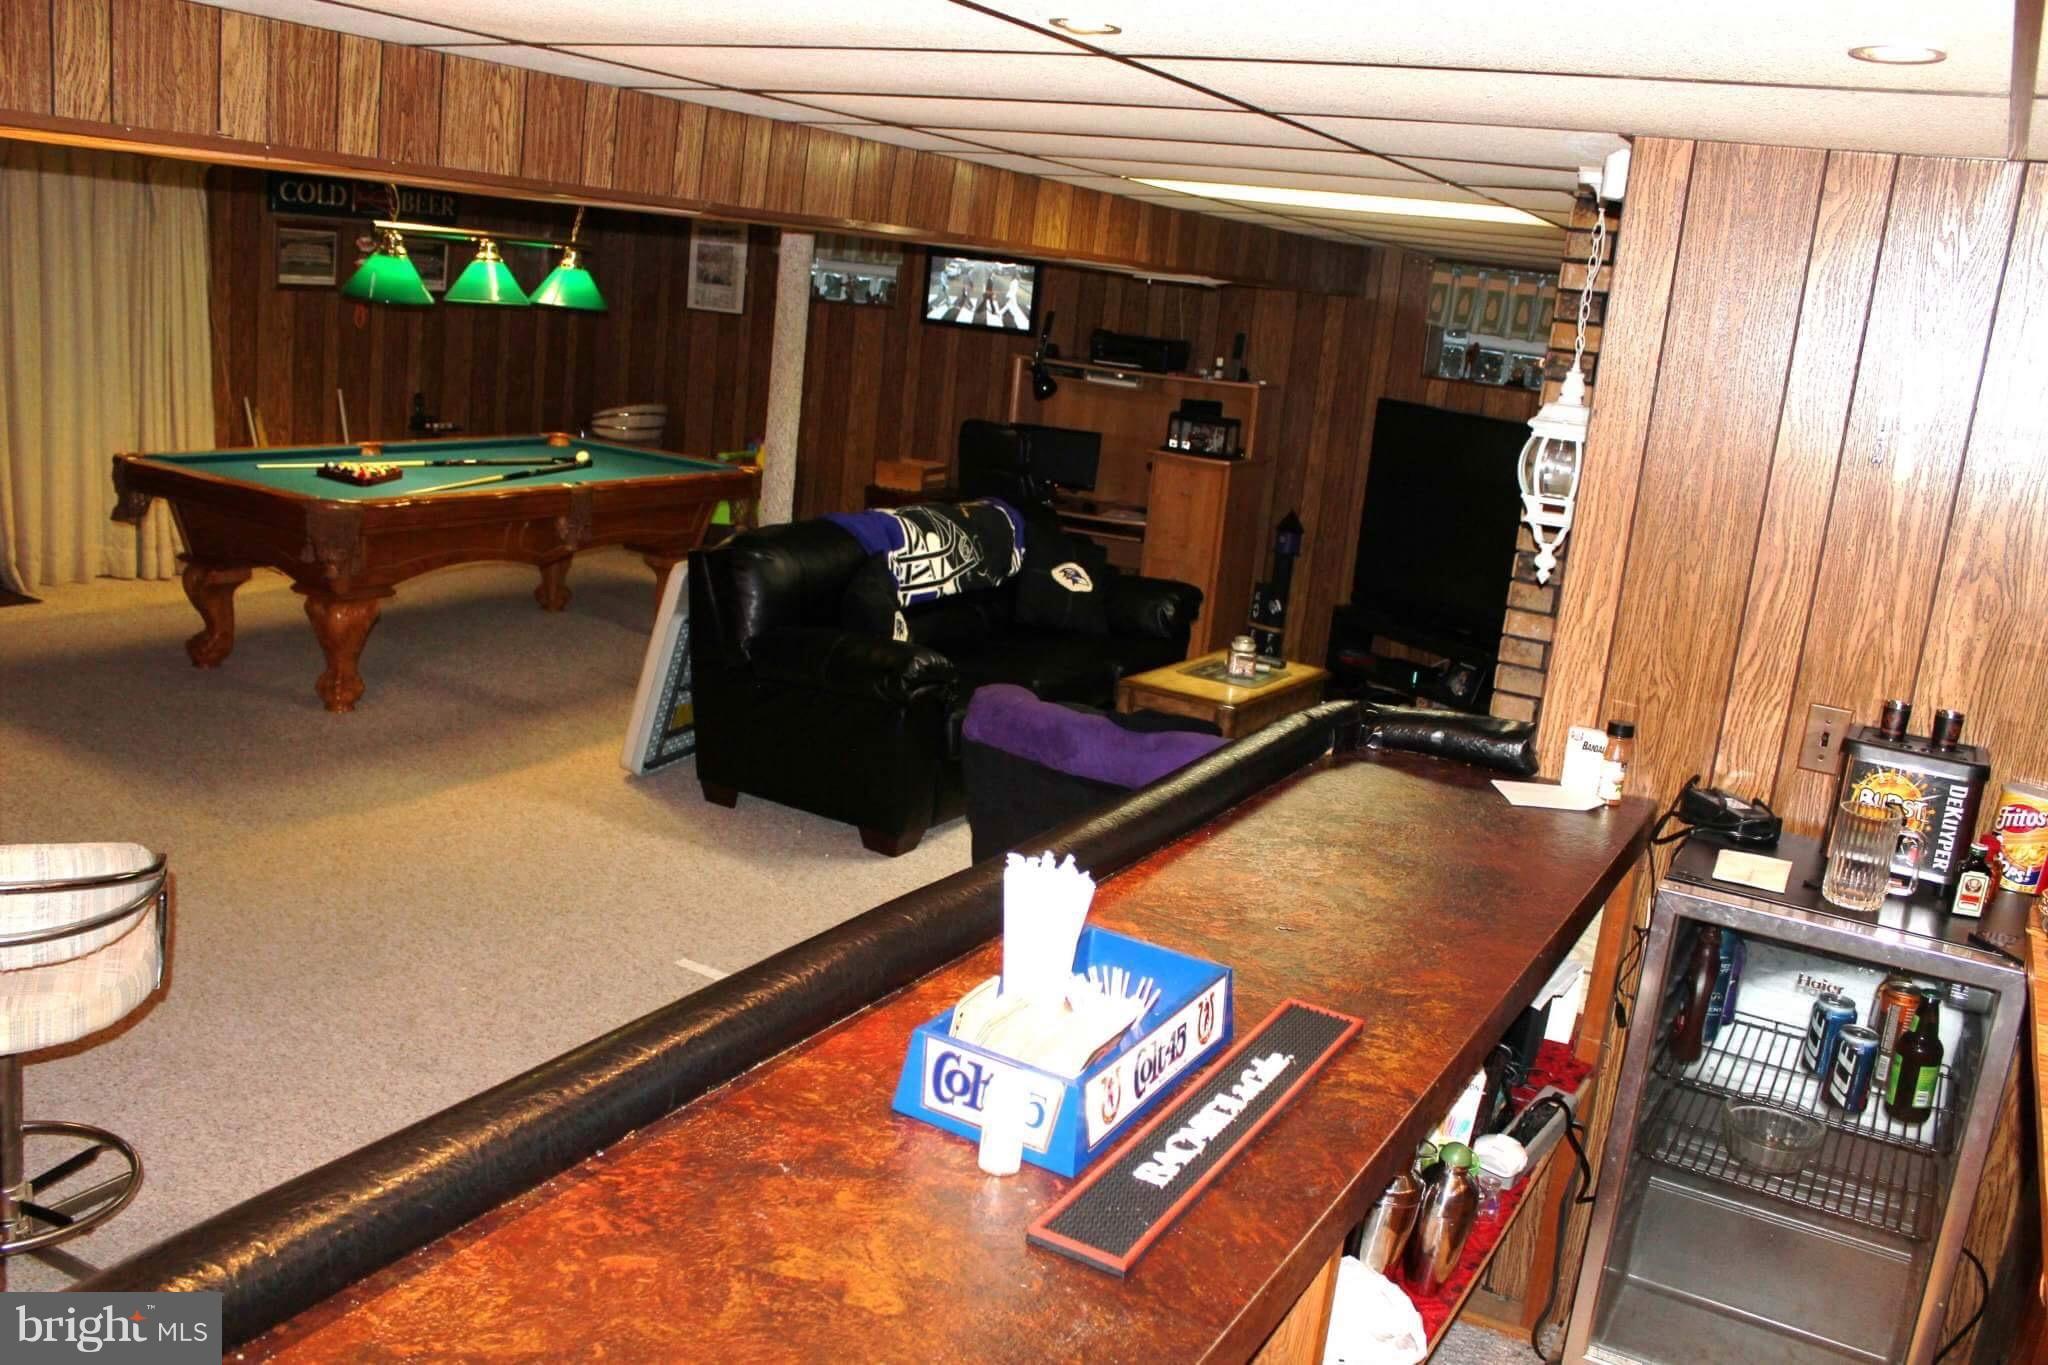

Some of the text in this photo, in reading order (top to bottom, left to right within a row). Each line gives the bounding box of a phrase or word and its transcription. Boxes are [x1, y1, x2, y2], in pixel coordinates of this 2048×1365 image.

[279, 179, 456, 217] COLD BEER
[1932, 784, 1969, 872] DEKUYPER
[1994, 806, 2048, 830] Fritos
[1796, 973, 1845, 995] Haier
[1804, 1008, 1826, 1071] ICE
[1829, 1039, 1857, 1108] ICE
